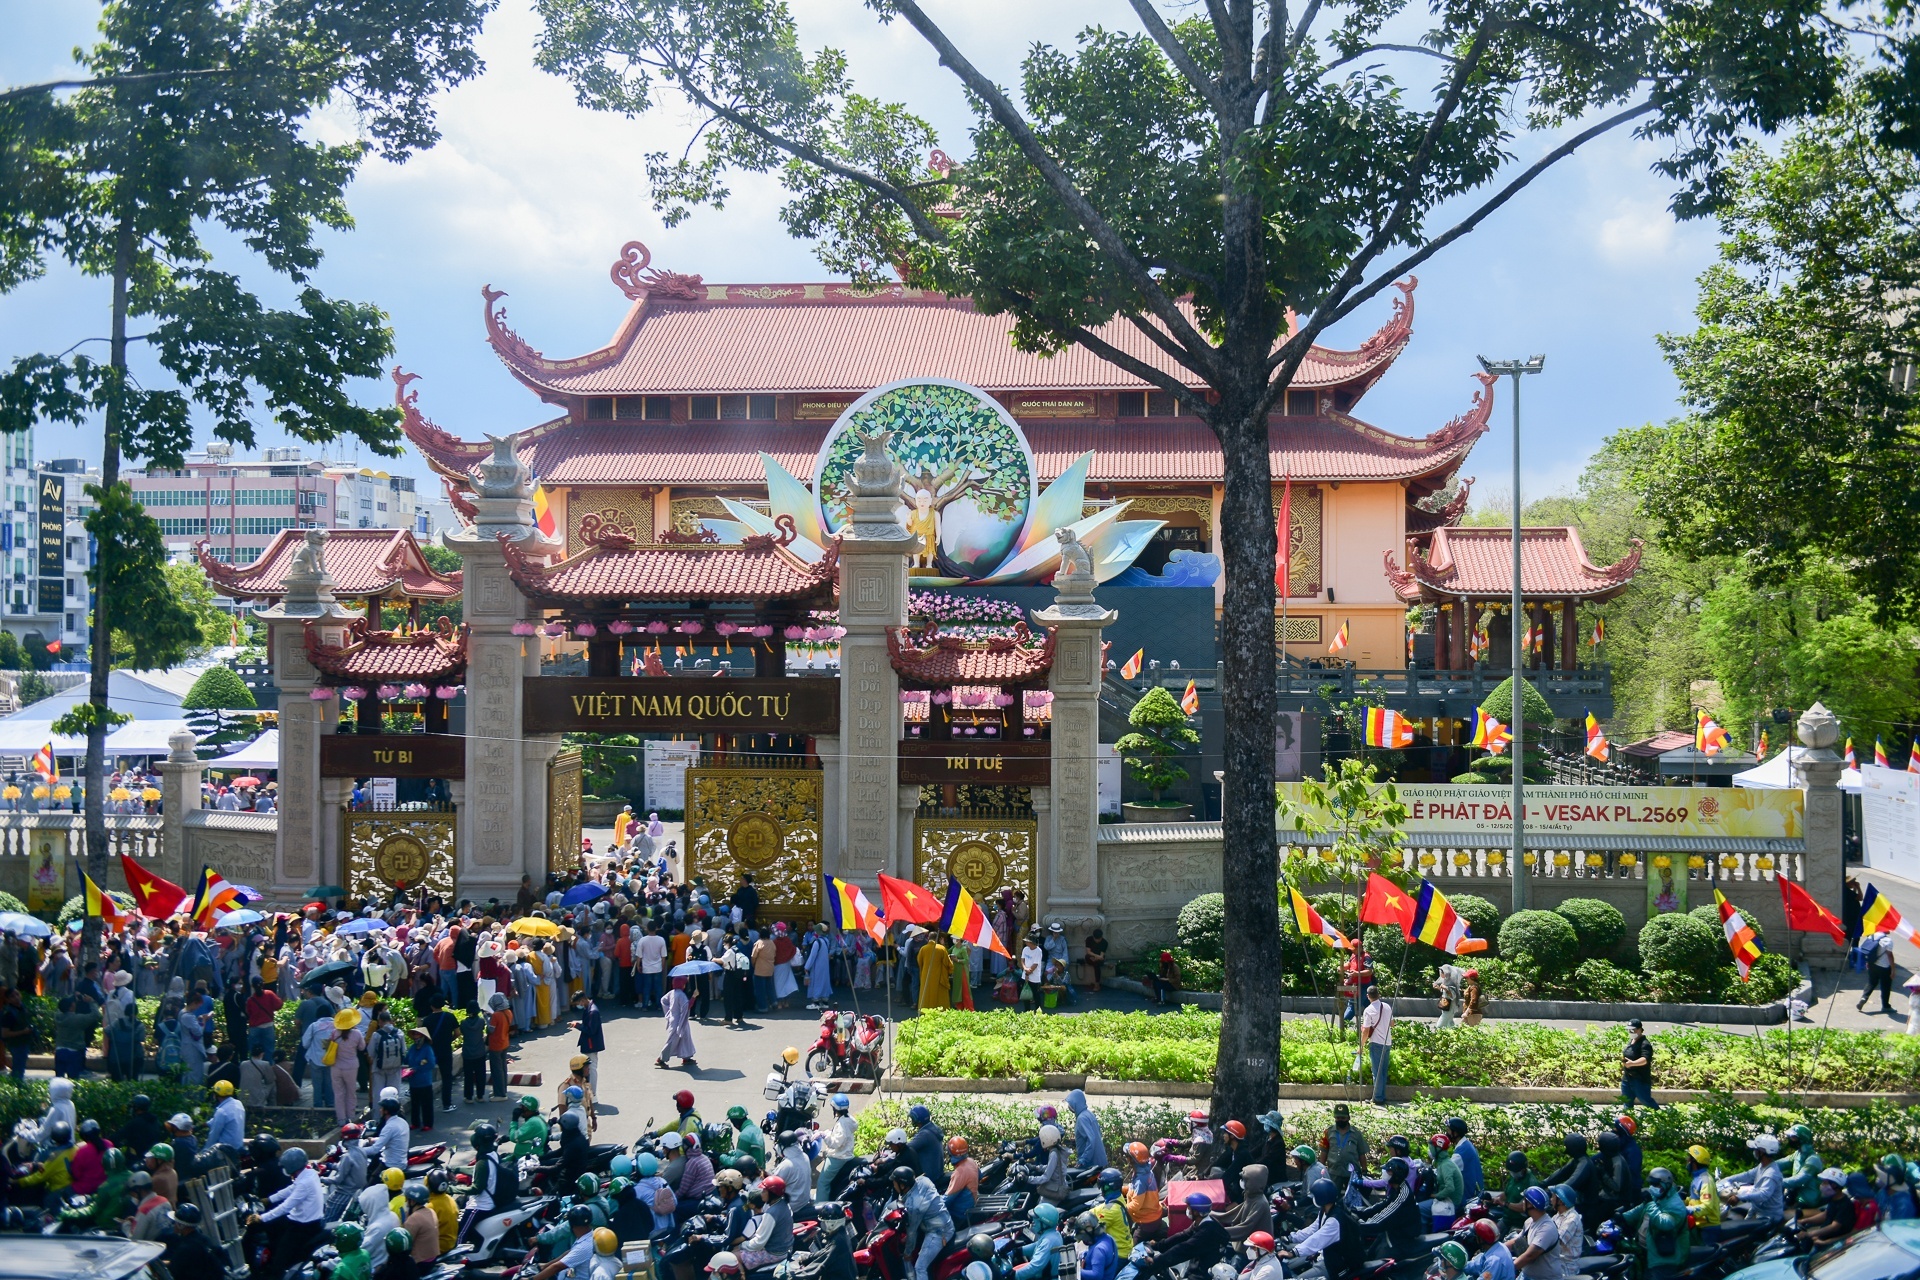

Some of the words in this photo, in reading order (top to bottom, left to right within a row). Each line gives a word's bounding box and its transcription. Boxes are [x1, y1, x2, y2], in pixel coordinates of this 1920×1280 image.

[41, 521, 62, 531] PHÒNG
[571, 691, 626, 720] VIỆT
[631, 695, 683, 717] NAM
[687, 691, 752, 720] QUỐC
[757, 692, 791, 721] TỰ
[373, 746, 395, 764] TỪ
[398, 750, 413, 764] BI
[945, 752, 969, 770] TRÍ
[974, 753, 1003, 773] TUỆ
[1402, 787, 1425, 798] GIÁO
[1426, 788, 1442, 799] HỘI
[1444, 787, 1468, 801] PHẬT
[1468, 788, 1491, 798] GIÁO
[1492, 788, 1512, 800] VIỆT
[1535, 789, 1568, 799] THÀNH
[1569, 789, 1589, 799] PHỐ
[1604, 790, 1621, 800] CHÍ
[1622, 792, 1648, 800] MINH
[1428, 801, 1480, 821] PHẬT
[1482, 801, 1527, 821] ĐẢ
[1543, 804, 1610, 822] VESAK
[1614, 805, 1689, 823] PL.2569
[854, 845, 882, 860] Nam
[1246, 1057, 1265, 1067] 182
